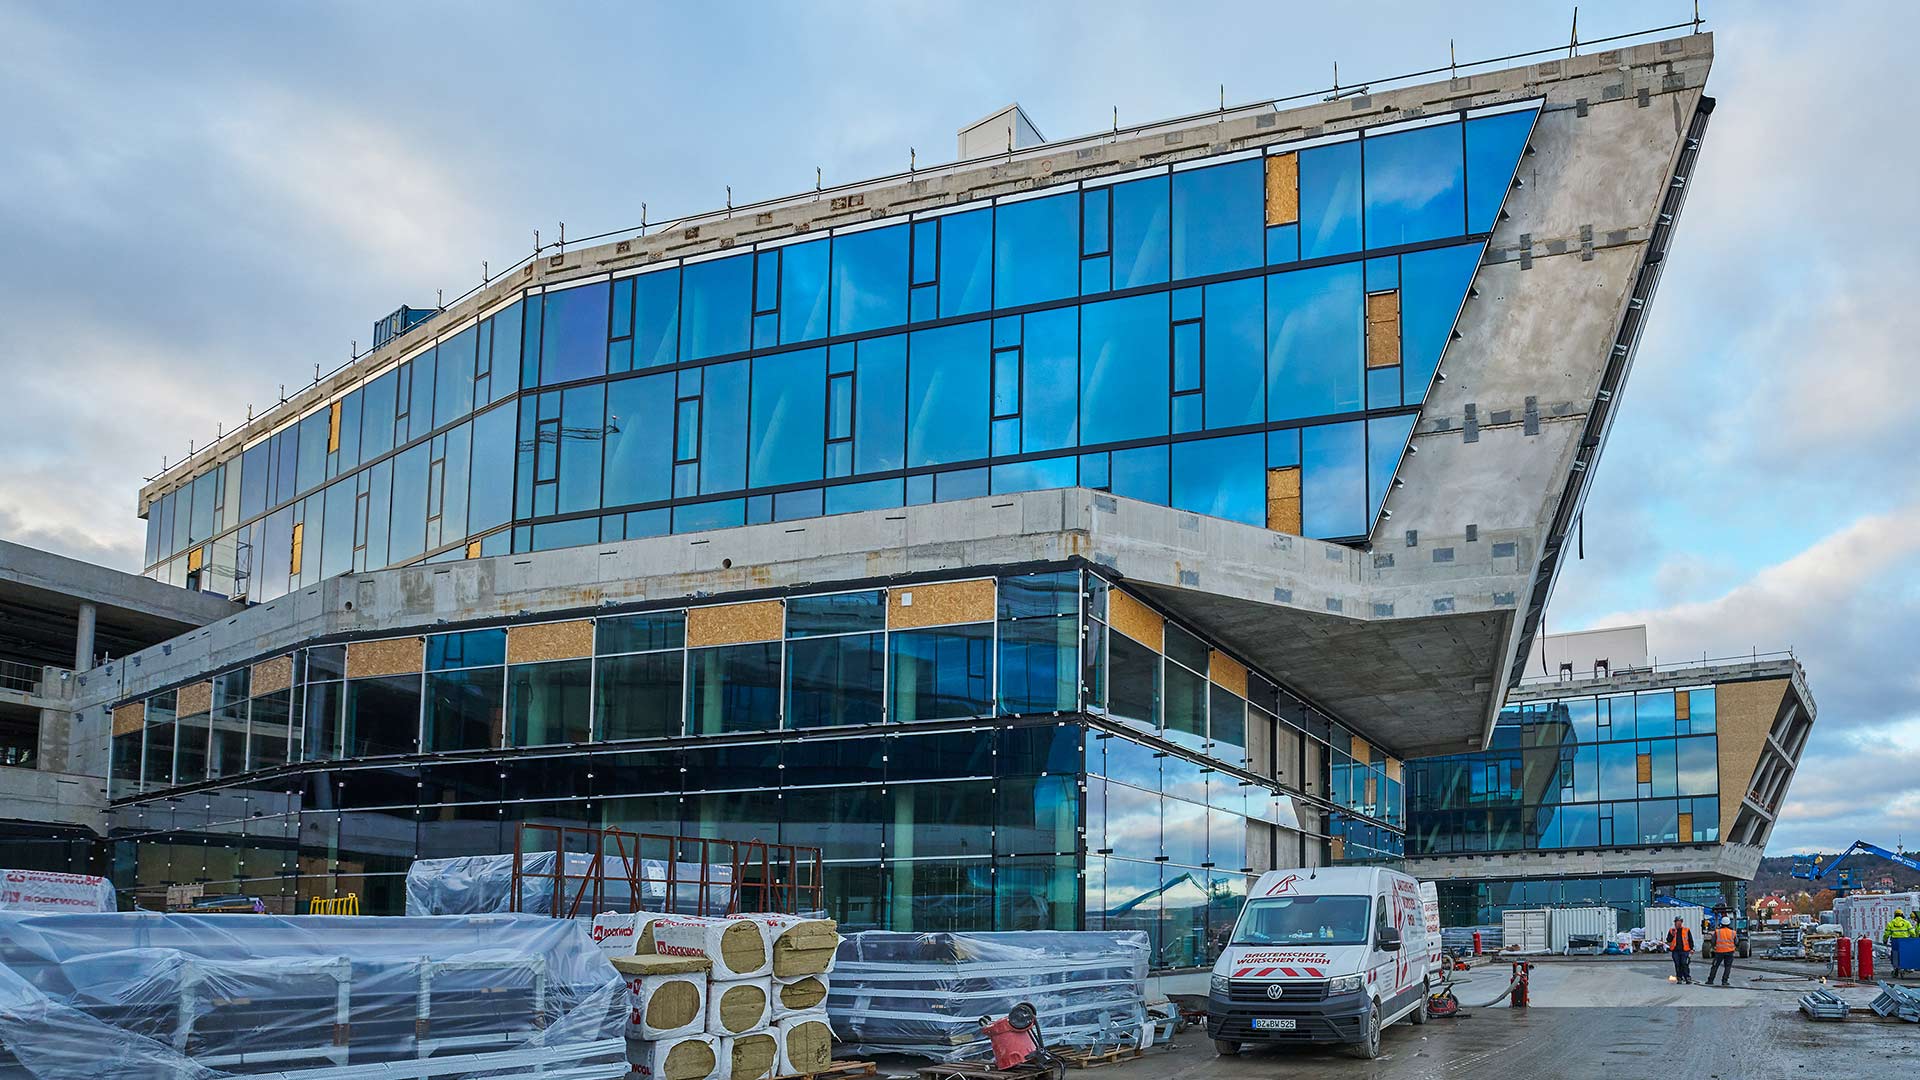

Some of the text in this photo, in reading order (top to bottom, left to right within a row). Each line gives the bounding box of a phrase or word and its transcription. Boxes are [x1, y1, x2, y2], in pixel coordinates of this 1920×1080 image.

[24, 896, 97, 907] ROCKWOOL
[1237, 957, 1331, 965] WURSCHEN GMBH
